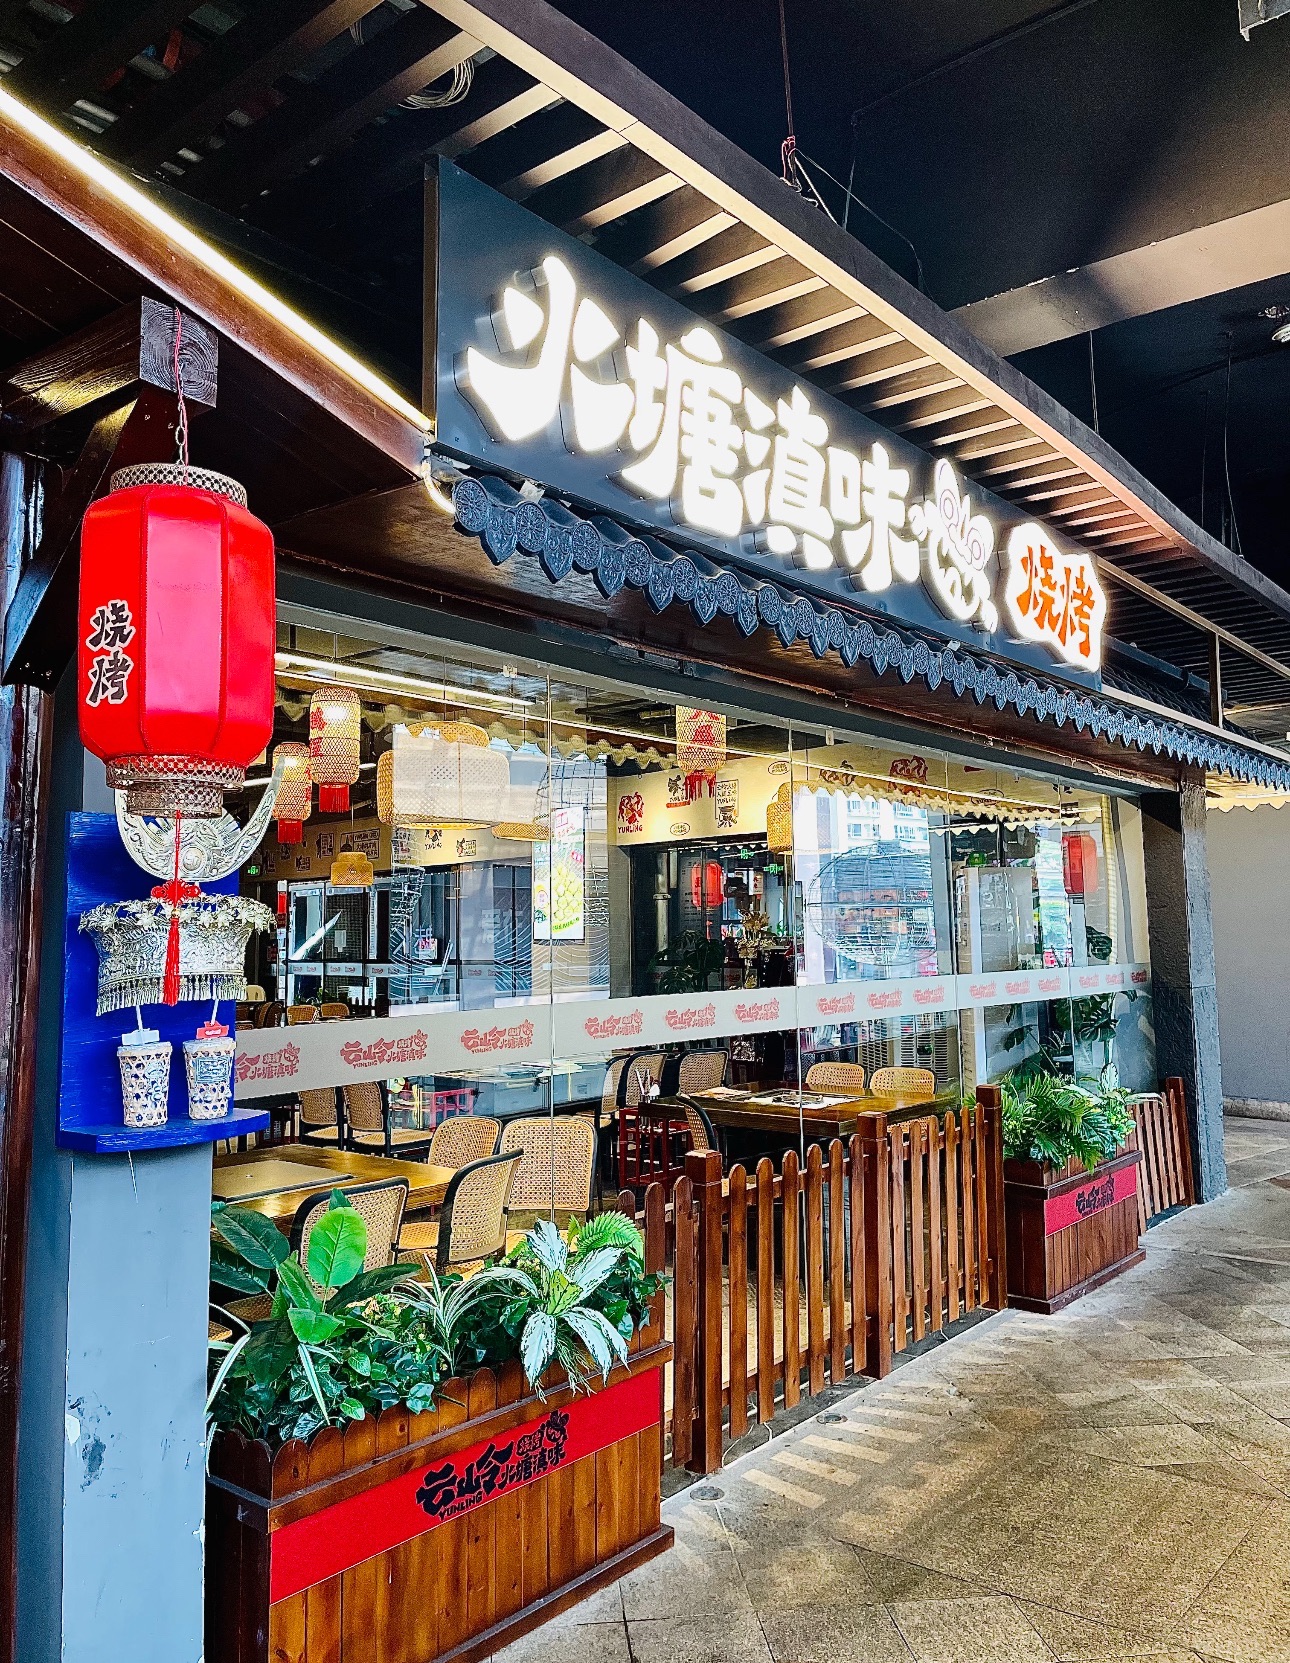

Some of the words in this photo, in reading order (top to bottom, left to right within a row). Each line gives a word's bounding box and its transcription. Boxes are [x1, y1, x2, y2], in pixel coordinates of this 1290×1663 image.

[467, 256, 919, 592] 火塘滇味
[88, 601, 134, 704] 烧烤
[1016, 543, 1096, 658] 烧烤
[439, 1491, 482, 1520] YUNLING
